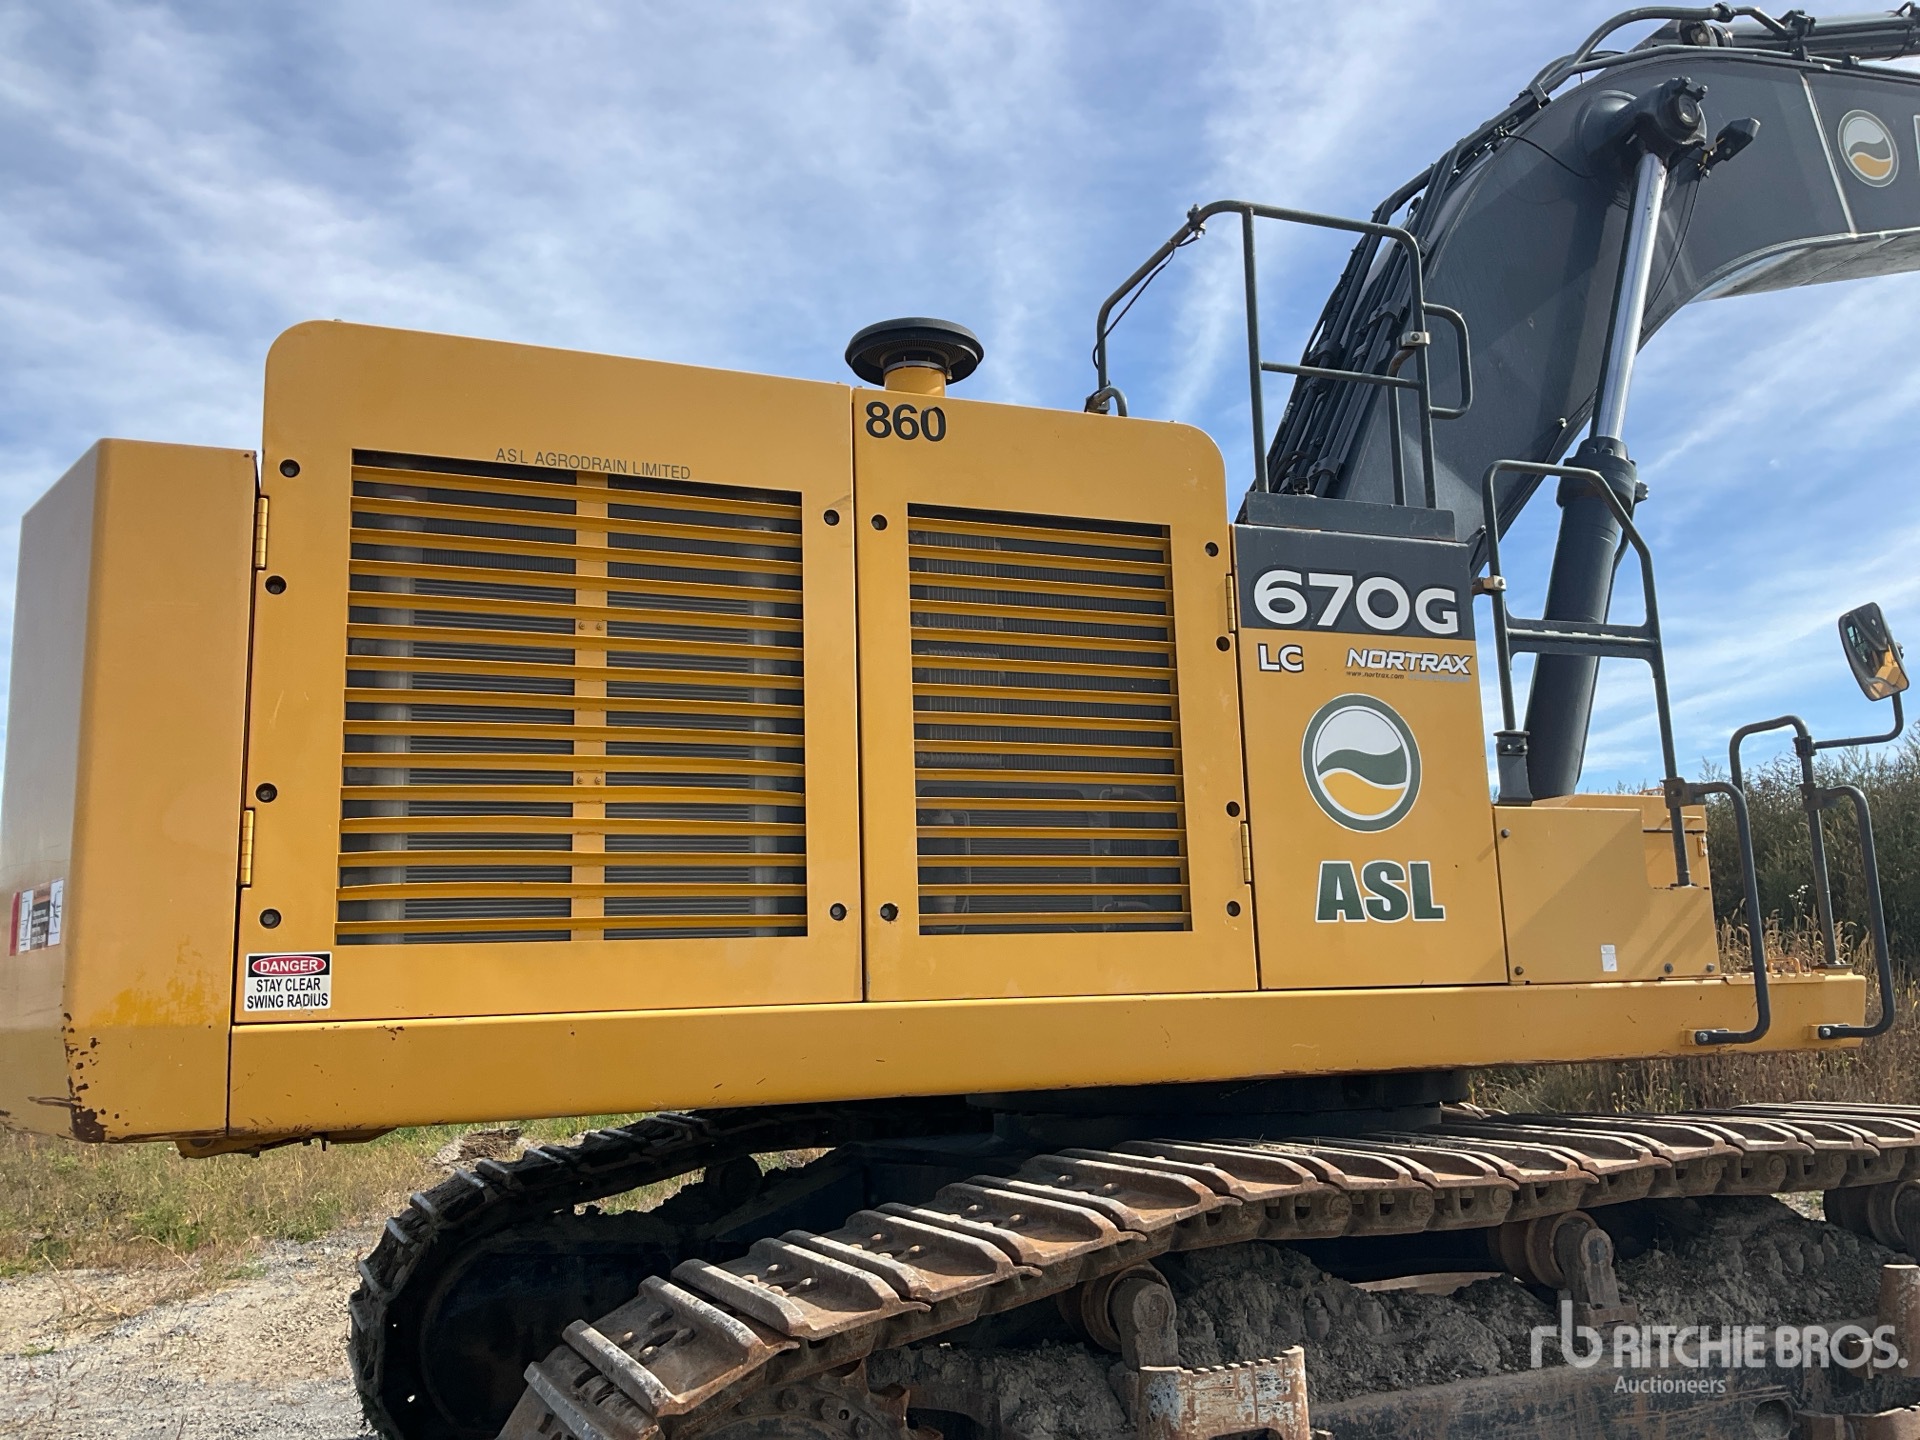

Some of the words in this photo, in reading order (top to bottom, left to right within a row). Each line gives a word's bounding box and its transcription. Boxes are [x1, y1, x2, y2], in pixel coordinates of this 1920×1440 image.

[865, 400, 947, 442] 860
[495, 448, 529, 465] ASL
[535, 452, 628, 473] AGRODRAIN
[632, 461, 691, 481] LIMITED
[1253, 569, 1460, 636] 670G
[1258, 643, 1304, 673] LC
[1345, 648, 1473, 675] NORTRAX
[1316, 860, 1445, 923] ASL
[260, 959, 318, 972] DANGER
[256, 978, 282, 992] STAY
[285, 977, 321, 991] CLEAR
[247, 995, 284, 1009] SWING
[286, 993, 328, 1007] RADIUS
